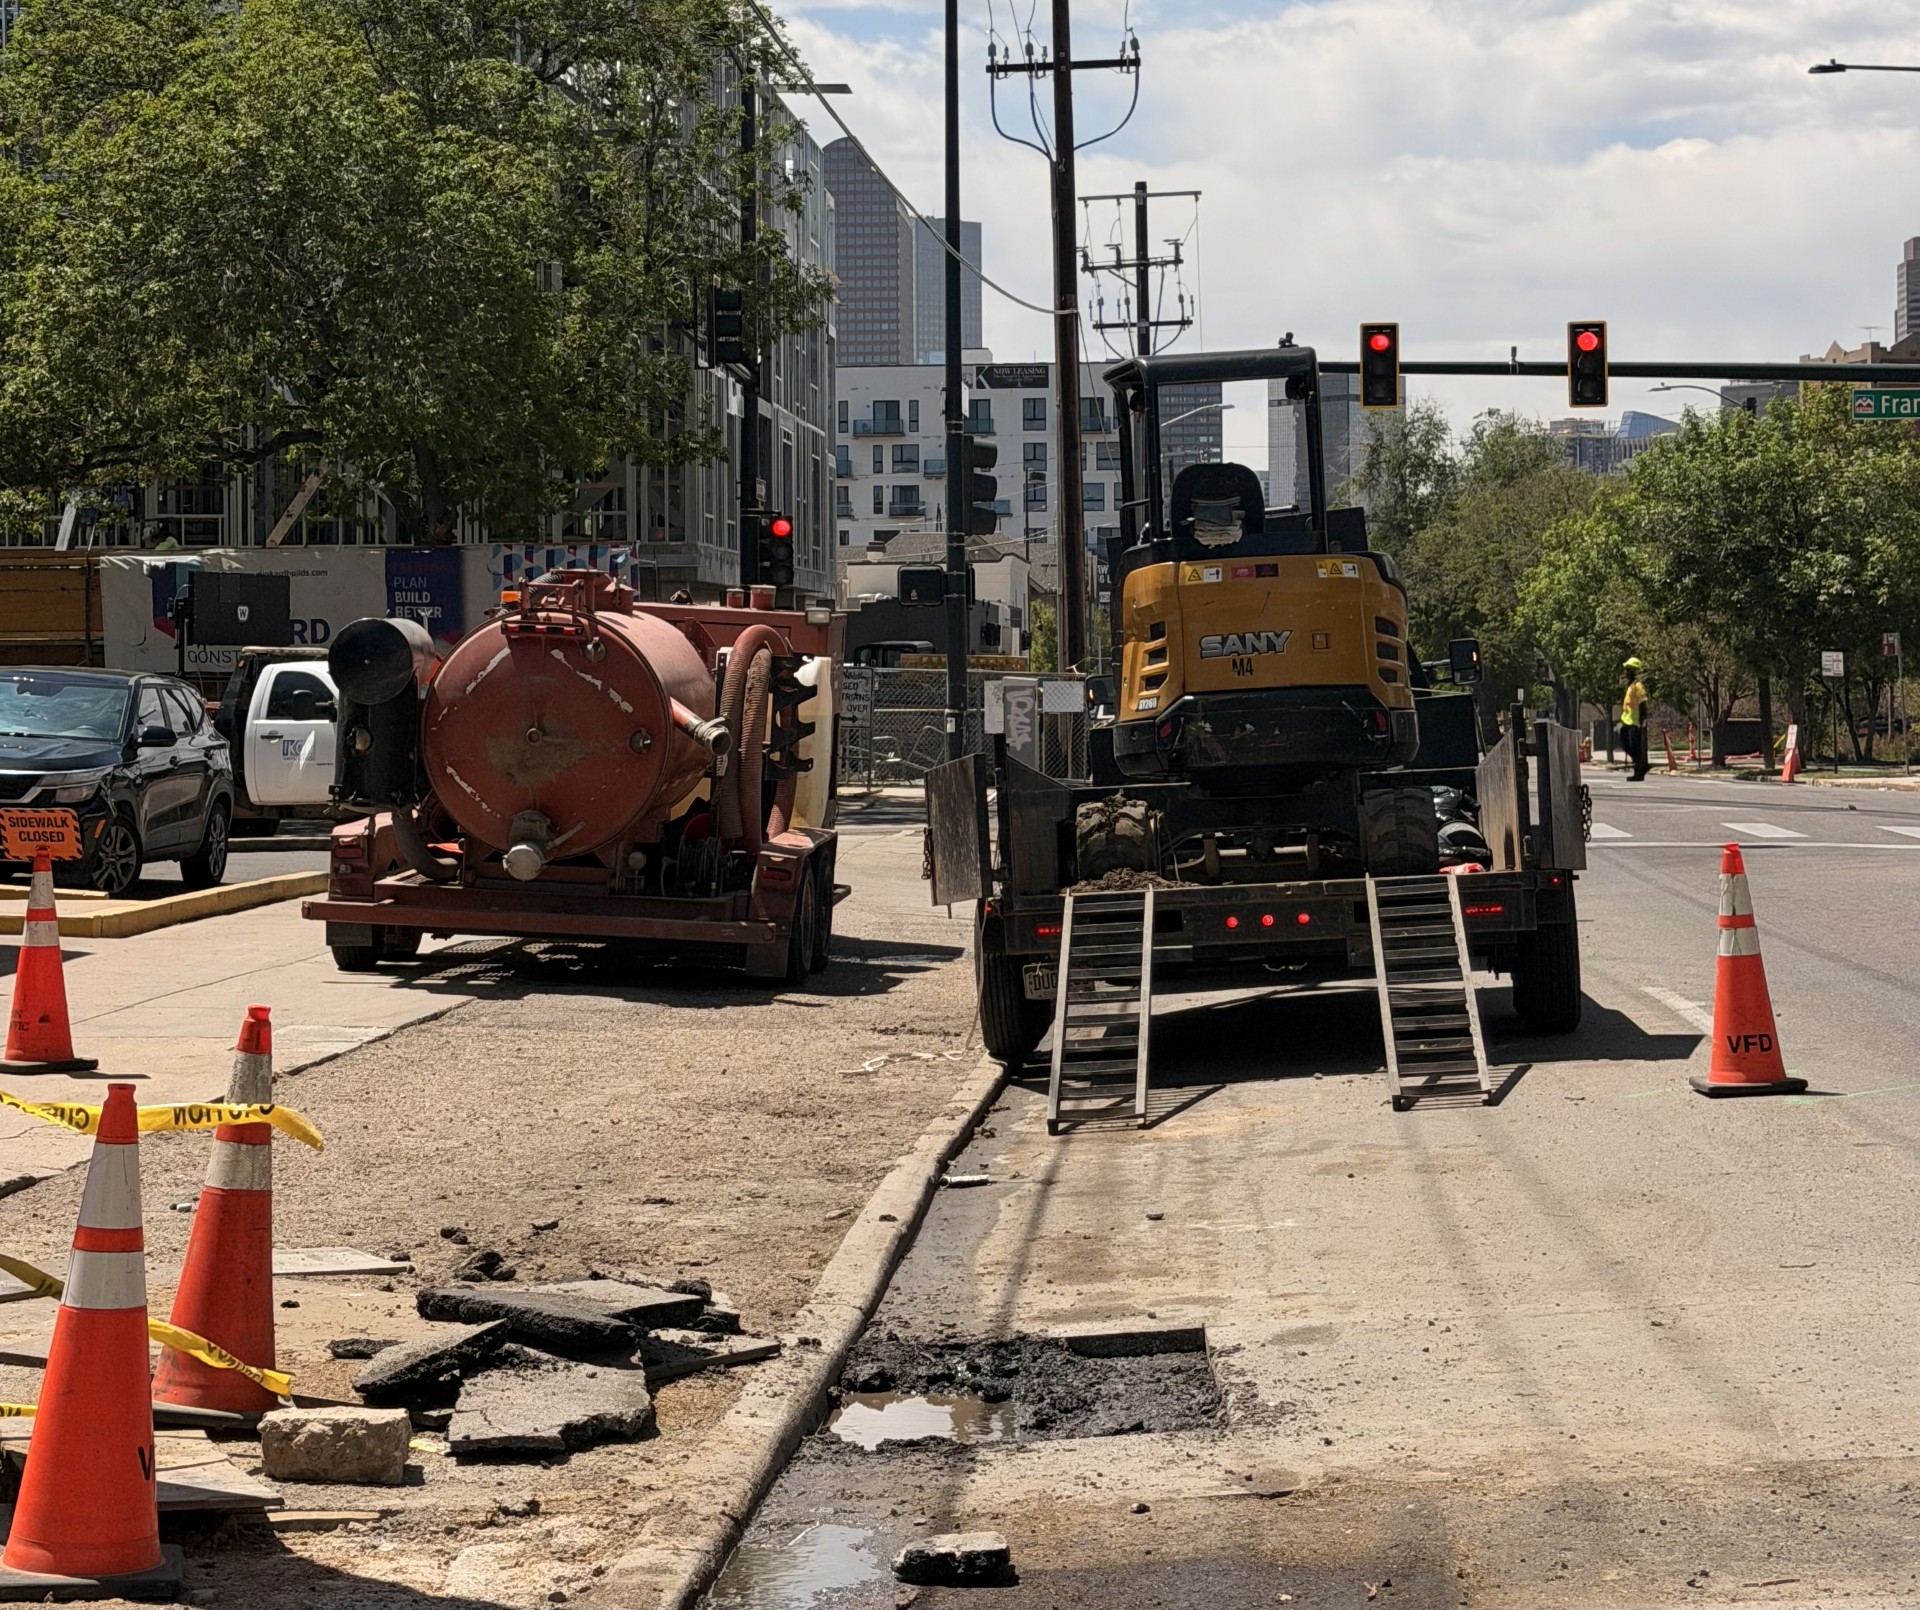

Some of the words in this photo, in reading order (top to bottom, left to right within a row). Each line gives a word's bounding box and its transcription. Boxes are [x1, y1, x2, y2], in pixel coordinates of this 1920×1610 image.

[993, 367, 1011, 375] NOW
[1013, 367, 1046, 375] LEASING
[393, 576, 427, 589] PLAN
[395, 591, 430, 603] BUILD
[395, 606, 442, 618] BETTER
[289, 619, 331, 645] RD
[1200, 630, 1293, 659] SANY
[843, 682, 858, 690] SED
[842, 693, 871, 702] TRIANS
[846, 704, 868, 713] OVER
[8, 816, 70, 828] SIDEWALK
[18, 830, 65, 842] CLOSED
[1726, 1033, 1773, 1054] VFD
